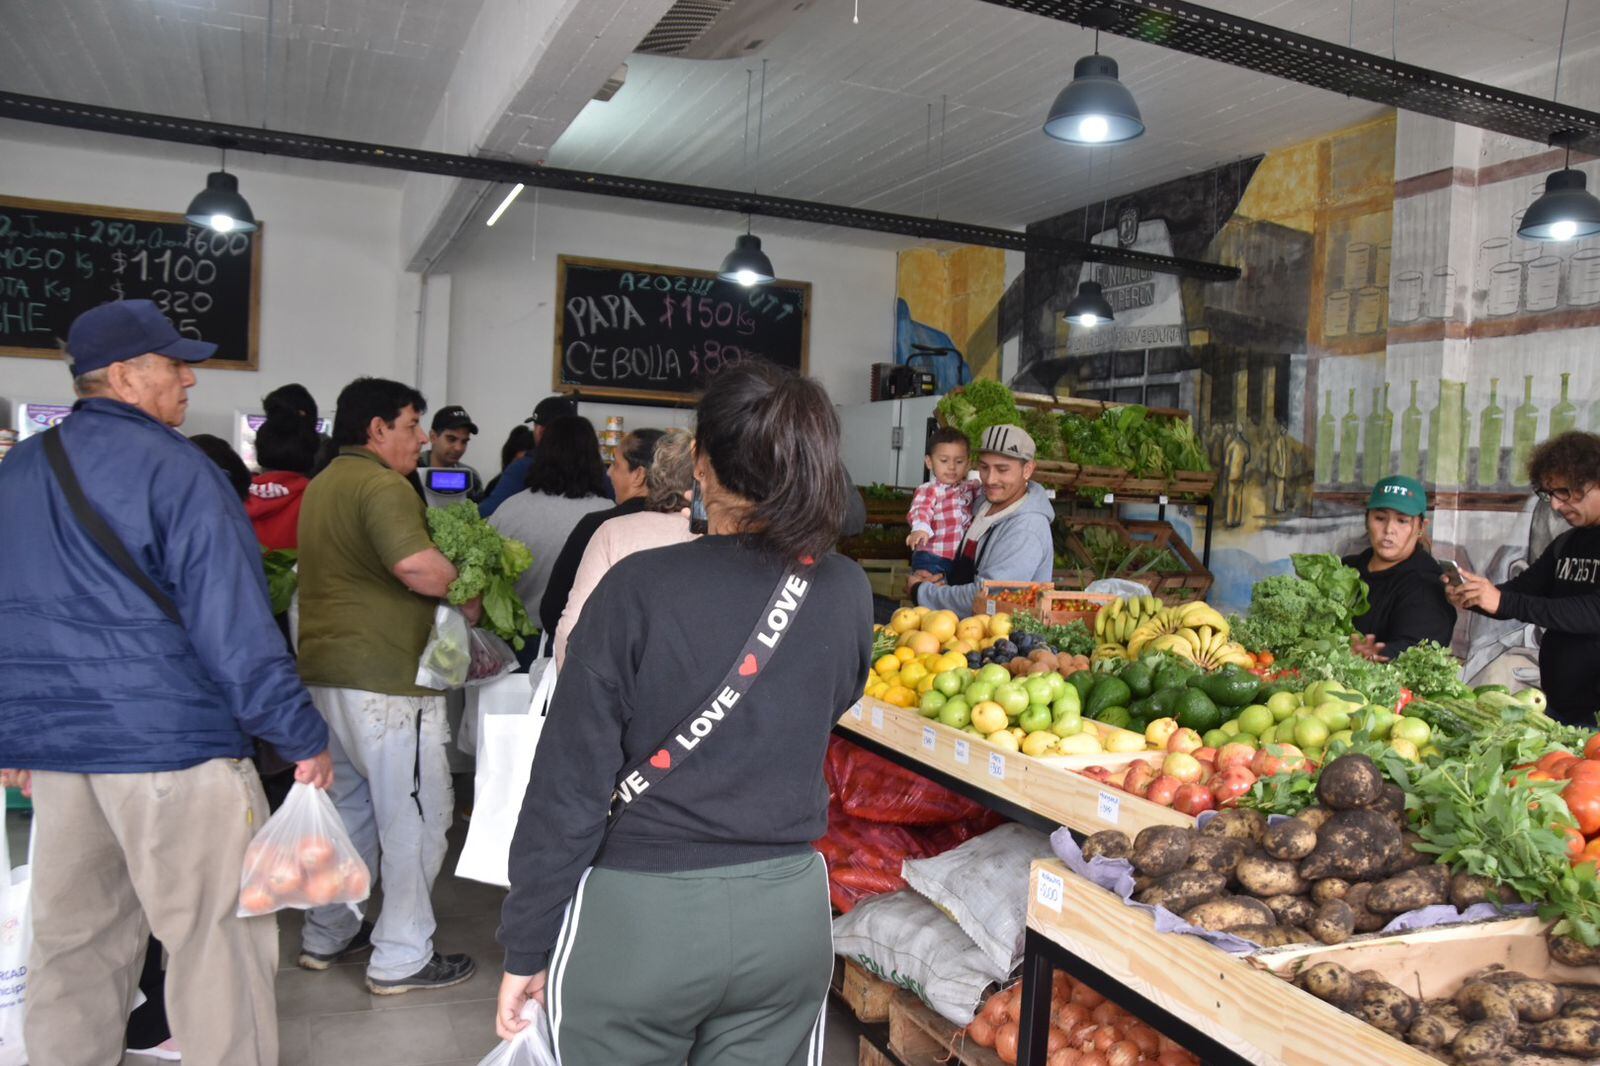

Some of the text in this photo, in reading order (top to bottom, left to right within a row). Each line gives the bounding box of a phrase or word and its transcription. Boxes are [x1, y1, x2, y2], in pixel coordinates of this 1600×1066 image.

[566, 294, 646, 339] PAPA
[565, 340, 682, 380] CEBOLLA
[1384, 485, 1408, 497] UTT
[757, 574, 808, 648] LOVE
[675, 686, 740, 750] LOVE
